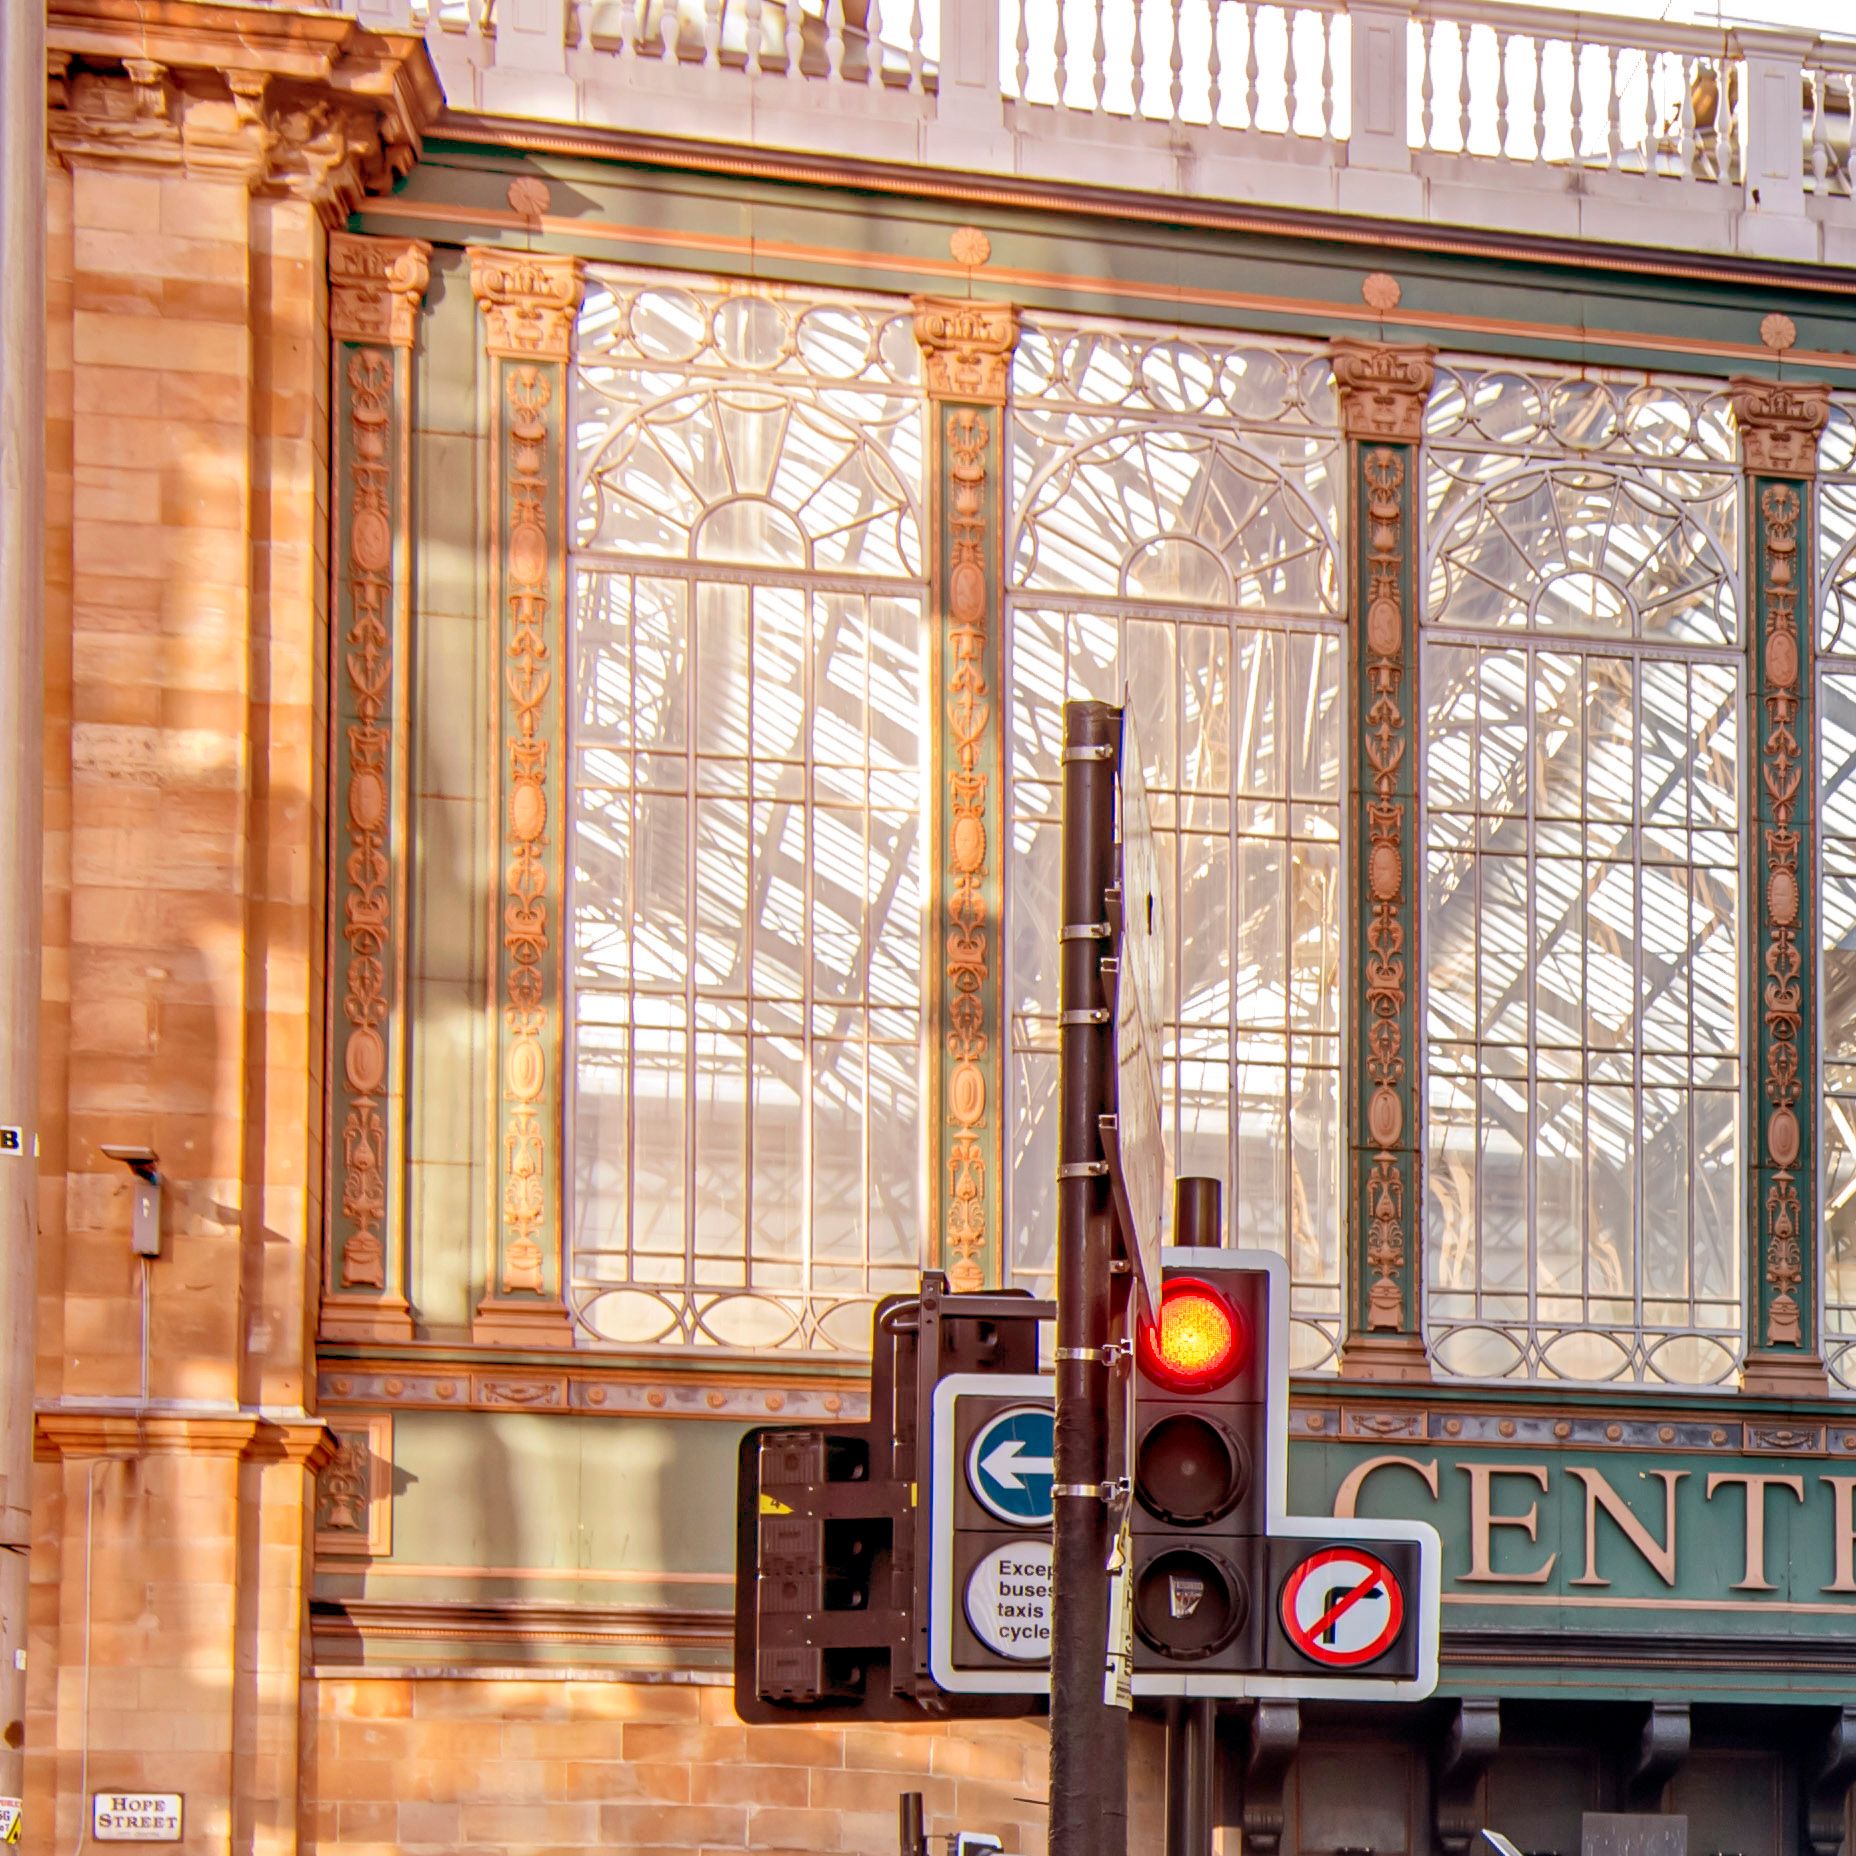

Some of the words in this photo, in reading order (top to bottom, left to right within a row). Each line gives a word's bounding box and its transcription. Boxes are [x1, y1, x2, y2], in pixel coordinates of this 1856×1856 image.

[999, 1559, 1053, 1580] Exce
[997, 1602, 1044, 1618] taxis
[999, 1623, 1050, 1642] cycle
[111, 1797, 166, 1812] HOPE
[99, 1813, 178, 1829] STREET
